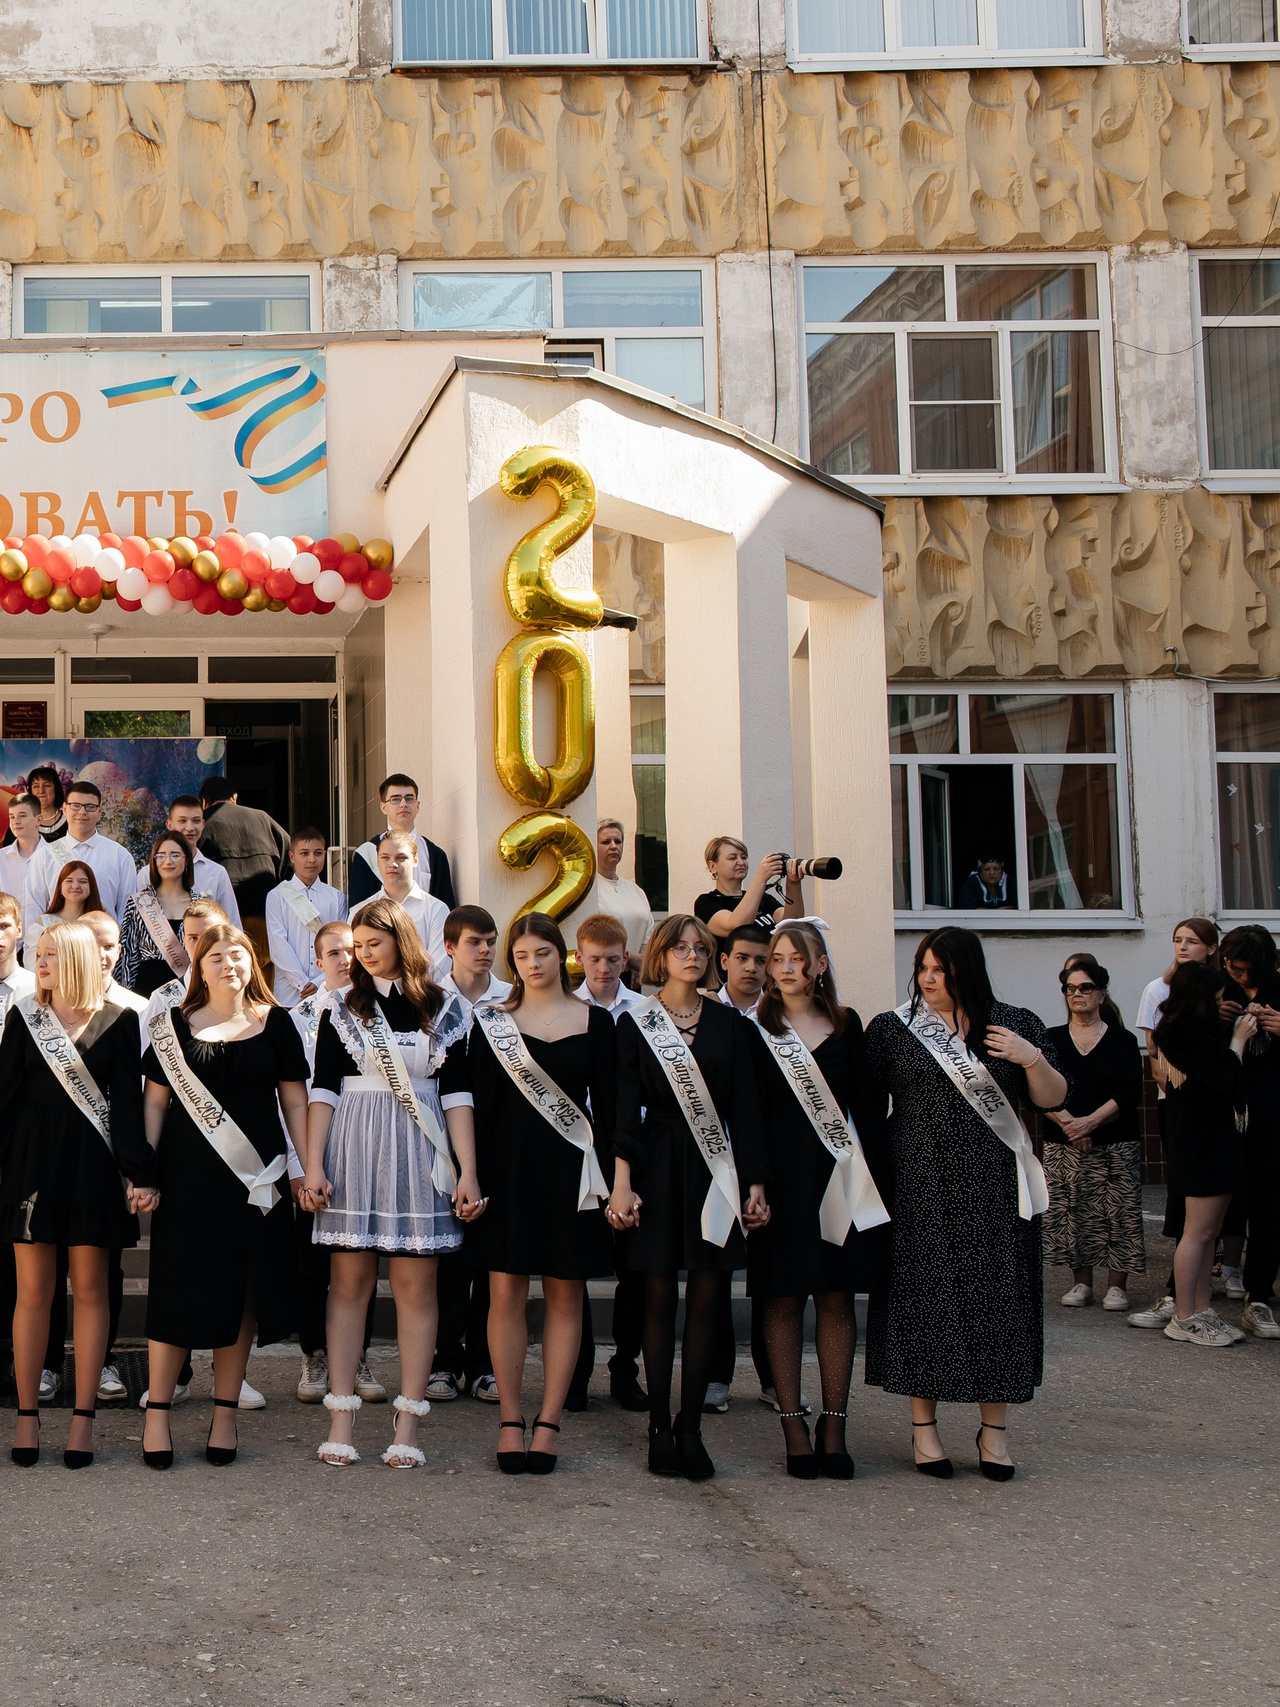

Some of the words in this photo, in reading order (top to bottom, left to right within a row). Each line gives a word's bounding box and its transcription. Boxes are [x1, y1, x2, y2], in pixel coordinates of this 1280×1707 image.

[218, 726, 251, 738] ВХОД
[37, 1028, 97, 1110] Выпускница
[152, 1027, 200, 1107] Выпускница
[488, 1025, 550, 1106] Выпускник
[549, 1098, 580, 1127] 2025
[651, 1035, 706, 1126] Выпускник
[700, 1125, 727, 1155] 2025
[768, 1034, 827, 1121] Выпускник
[822, 1119, 852, 1149] 2025
[974, 1086, 1005, 1113] 2025
